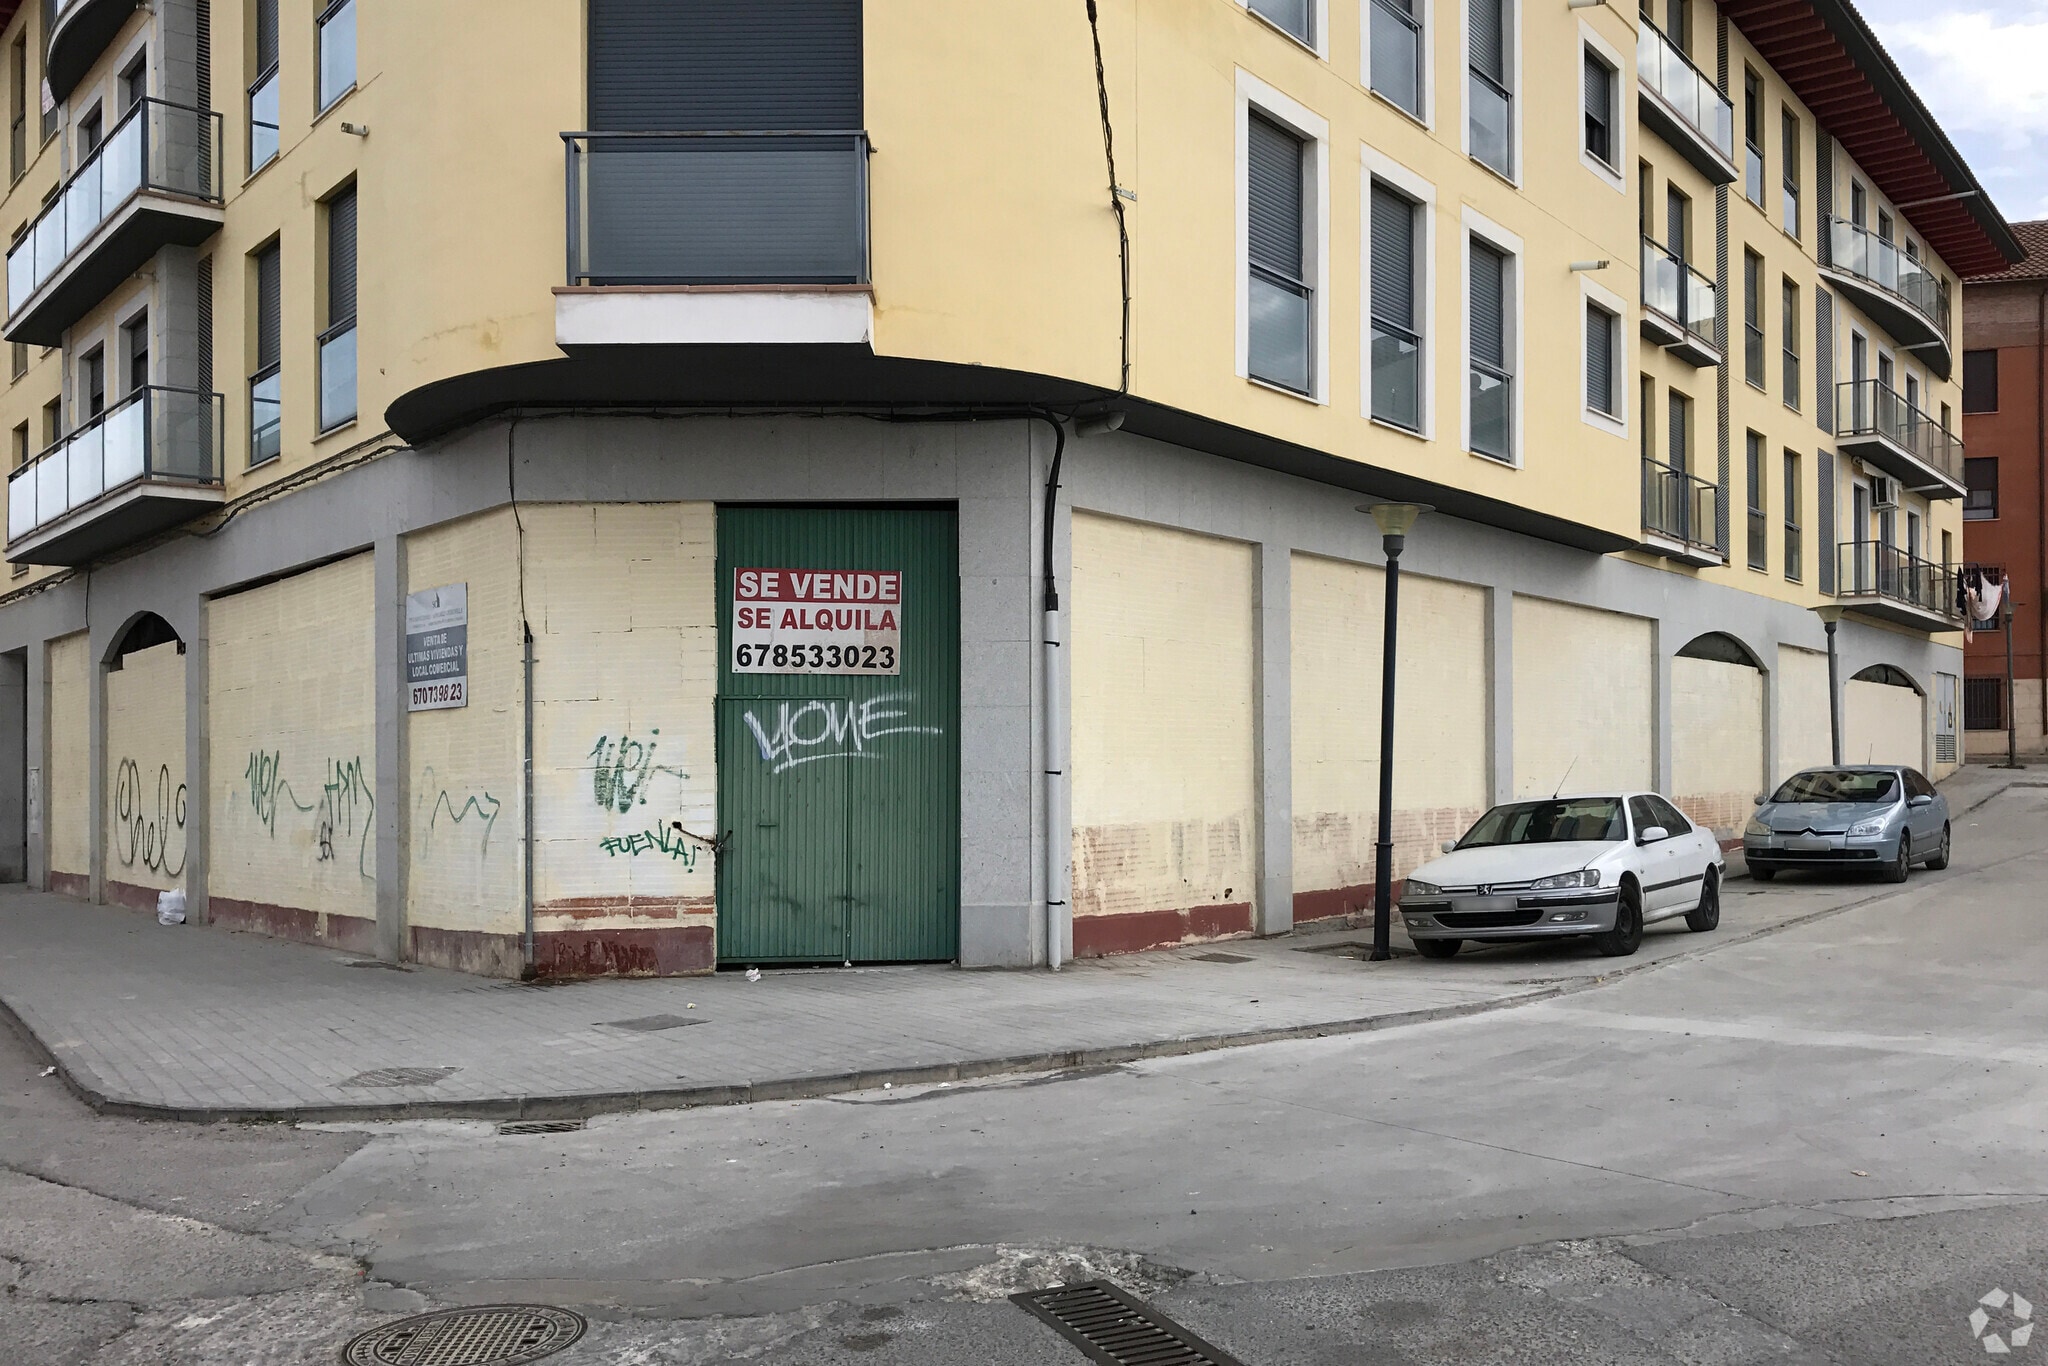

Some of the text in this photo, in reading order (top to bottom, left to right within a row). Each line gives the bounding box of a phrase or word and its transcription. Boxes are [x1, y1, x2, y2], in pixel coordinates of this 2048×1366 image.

[738, 572, 897, 600] SE VENDE
[738, 608, 897, 632] SE ALQUILA
[424, 633, 447, 646] VENTA DE
[430, 645, 458, 661] VIVIENDAS
[459, 645, 463, 656] Y
[736, 644, 895, 669] 678533023
[412, 661, 460, 677] LOCAL COMERCIAL
